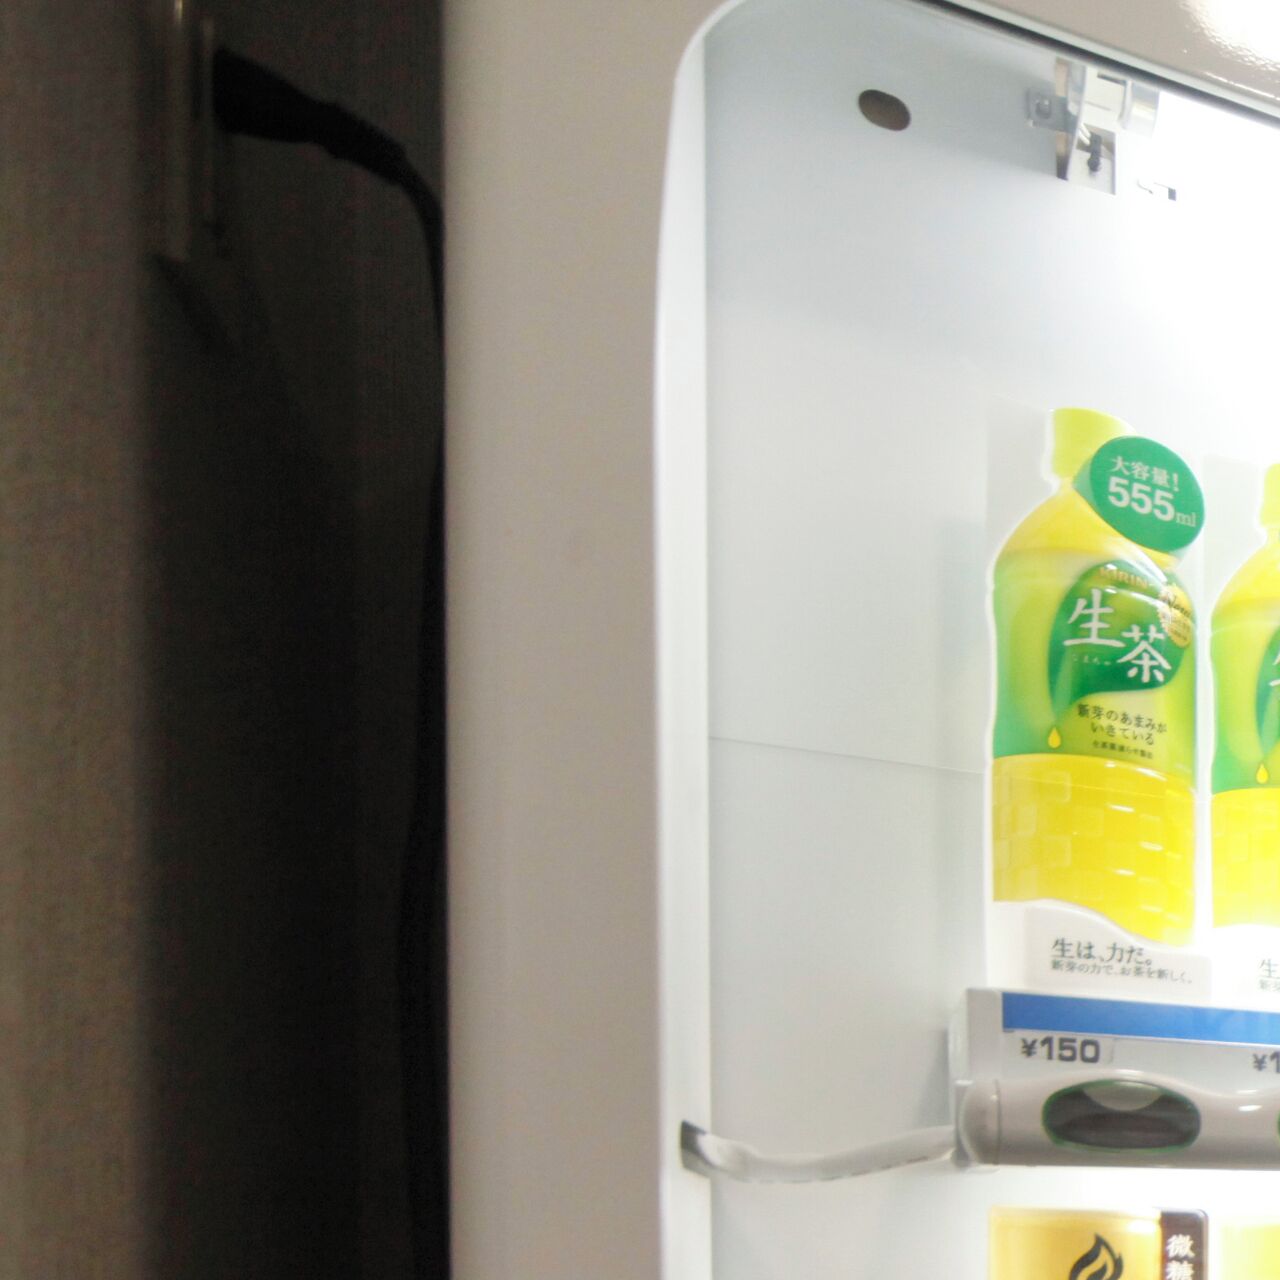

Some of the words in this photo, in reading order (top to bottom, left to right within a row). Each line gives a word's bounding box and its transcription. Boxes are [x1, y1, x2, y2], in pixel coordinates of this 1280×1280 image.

[1108, 476, 1196, 527] 555ml
[1064, 589, 1171, 682] 生茶
[1020, 1037, 1100, 1066] ¥150
